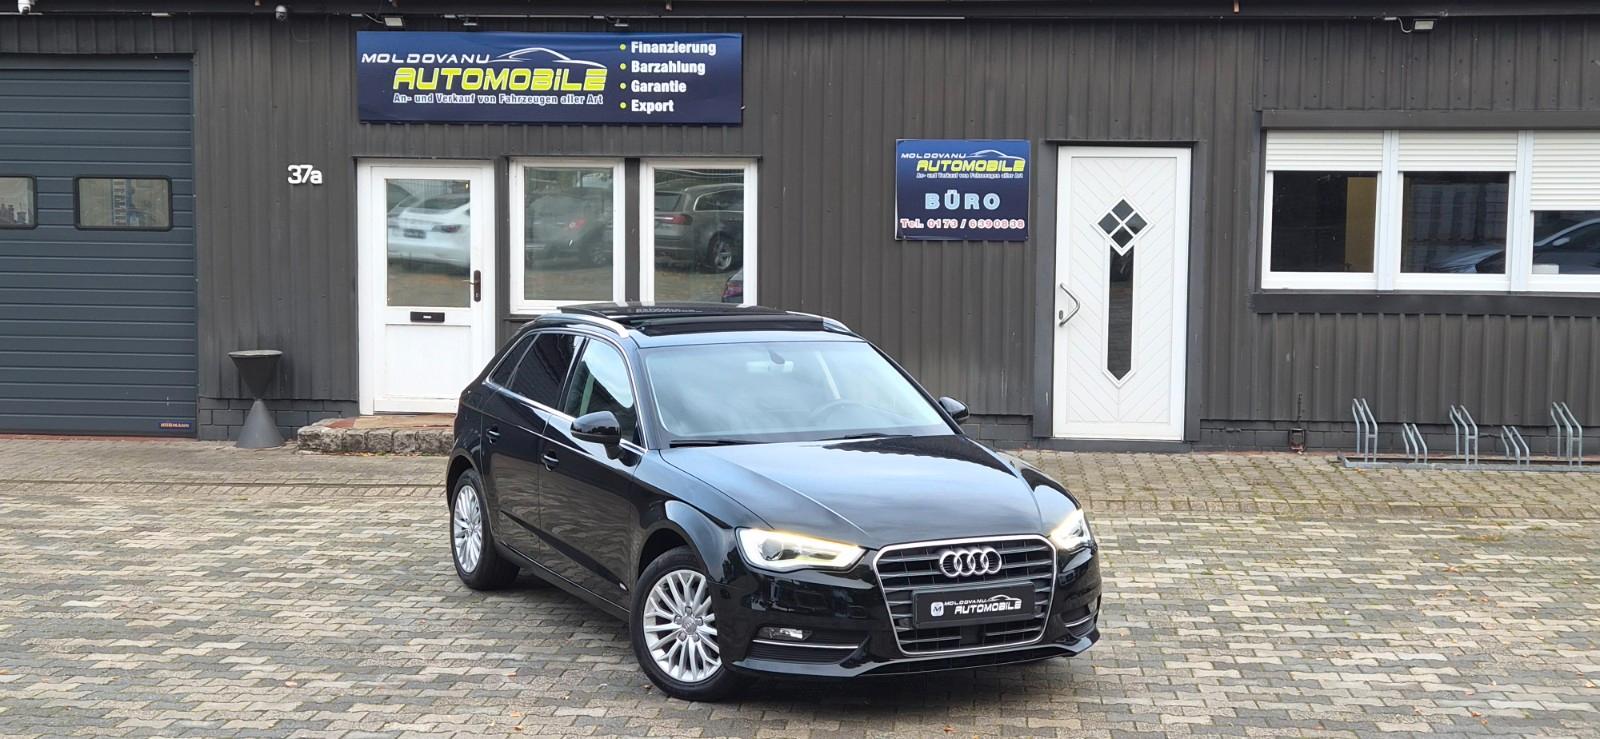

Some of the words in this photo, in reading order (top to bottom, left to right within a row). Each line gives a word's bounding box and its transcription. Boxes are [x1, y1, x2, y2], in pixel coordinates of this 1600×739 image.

[631, 41, 716, 56] Finanzierung
[361, 53, 490, 64] MOLDOVANU
[631, 60, 706, 75] Barzahlung
[631, 80, 687, 93] Garantie
[393, 93, 412, 103] An-
[414, 93, 434, 104] und
[435, 93, 476, 104] Verkauf
[477, 95, 497, 104] von
[498, 93, 559, 106] Fahrzeugen
[560, 94, 585, 105] aller
[586, 94, 604, 105] Art
[631, 99, 675, 114] Export
[287, 164, 323, 184] 37a
[924, 189, 1000, 210] BÜRO
[900, 219, 925, 229] Tel.
[926, 219, 959, 229] 0173
[960, 219, 967, 229] /
[968, 219, 1025, 229] 6390838
